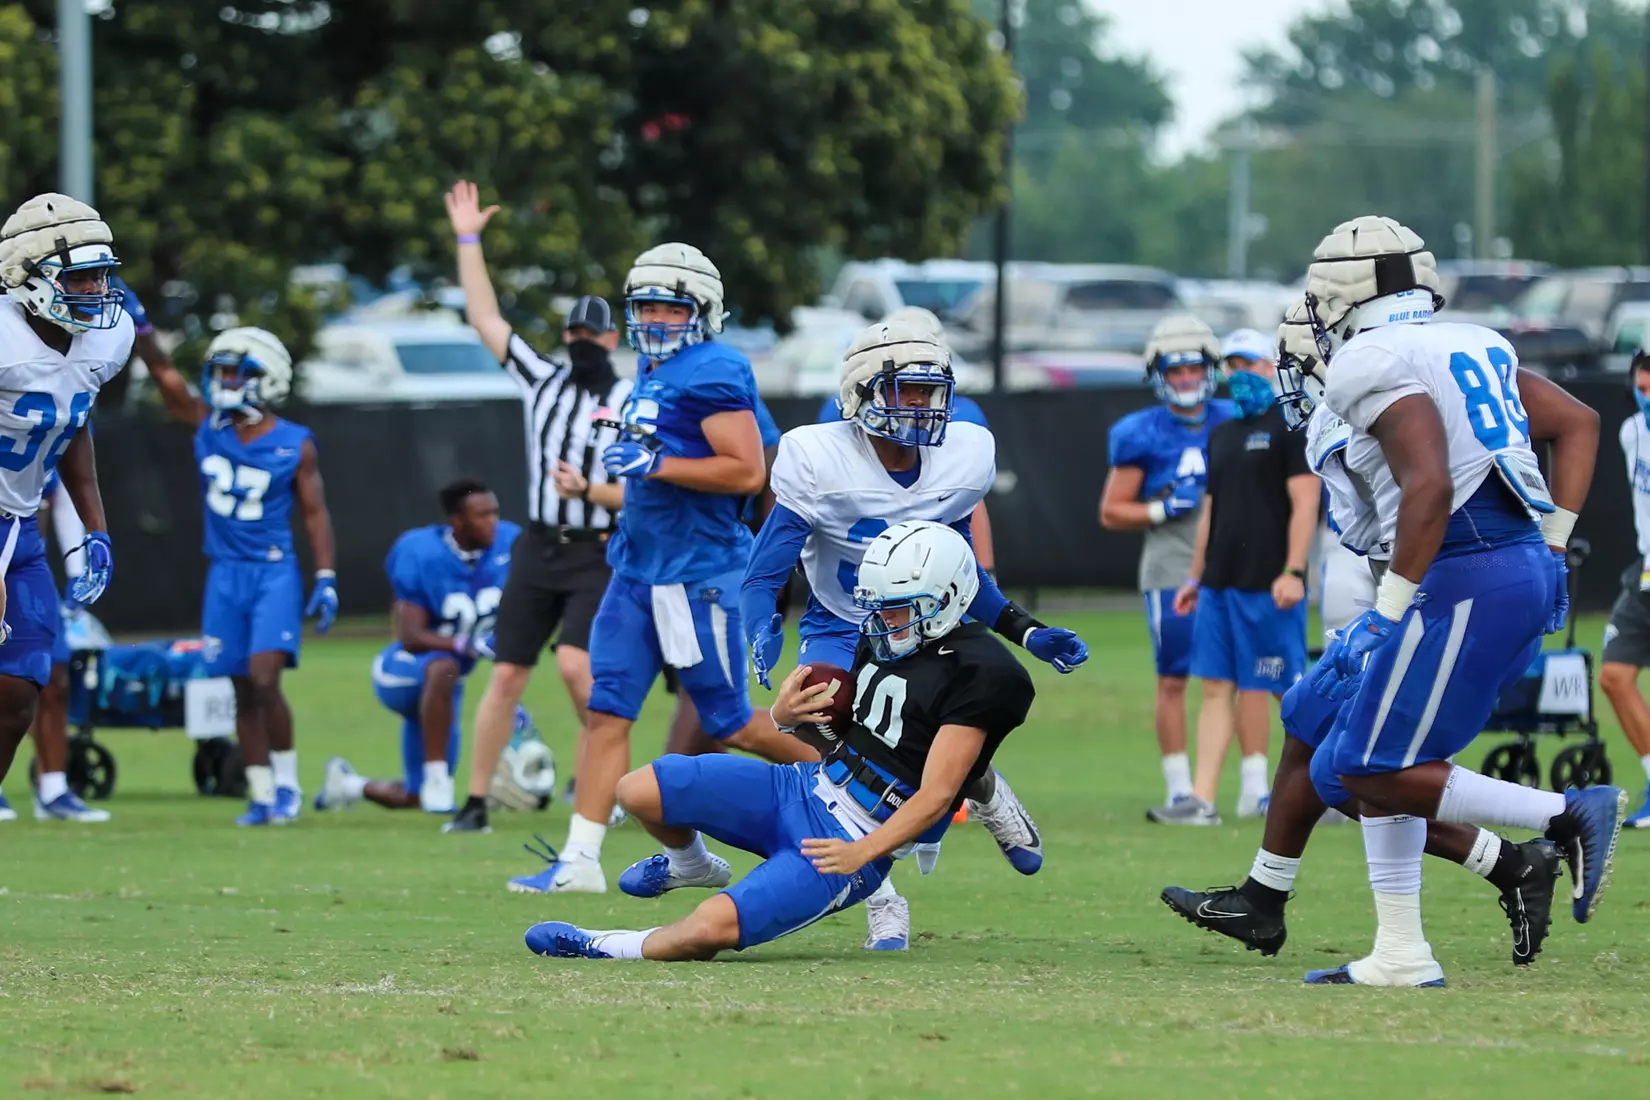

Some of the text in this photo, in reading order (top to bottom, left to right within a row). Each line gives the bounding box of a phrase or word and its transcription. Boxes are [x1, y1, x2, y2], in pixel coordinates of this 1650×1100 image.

[1389, 311, 1411, 322] BLUE
[1553, 673, 1585, 698] WR
[852, 662, 908, 749] 10
